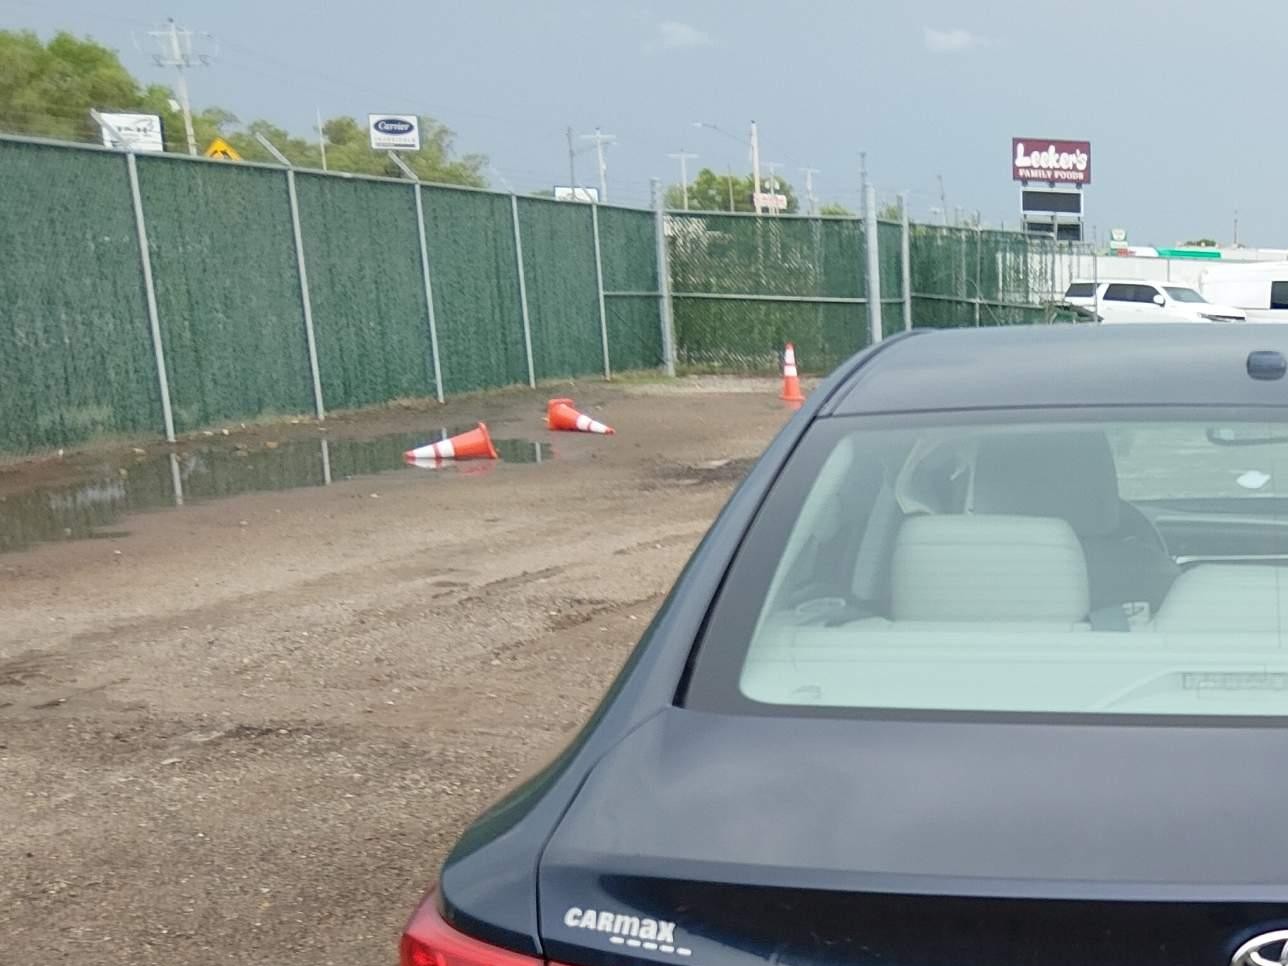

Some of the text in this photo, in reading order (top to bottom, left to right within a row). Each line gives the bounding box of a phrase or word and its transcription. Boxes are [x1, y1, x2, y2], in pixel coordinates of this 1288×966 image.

[378, 121, 410, 131] Carrier
[1015, 142, 1088, 171] Leeker's
[1018, 168, 1084, 180] FAMILY FOODS
